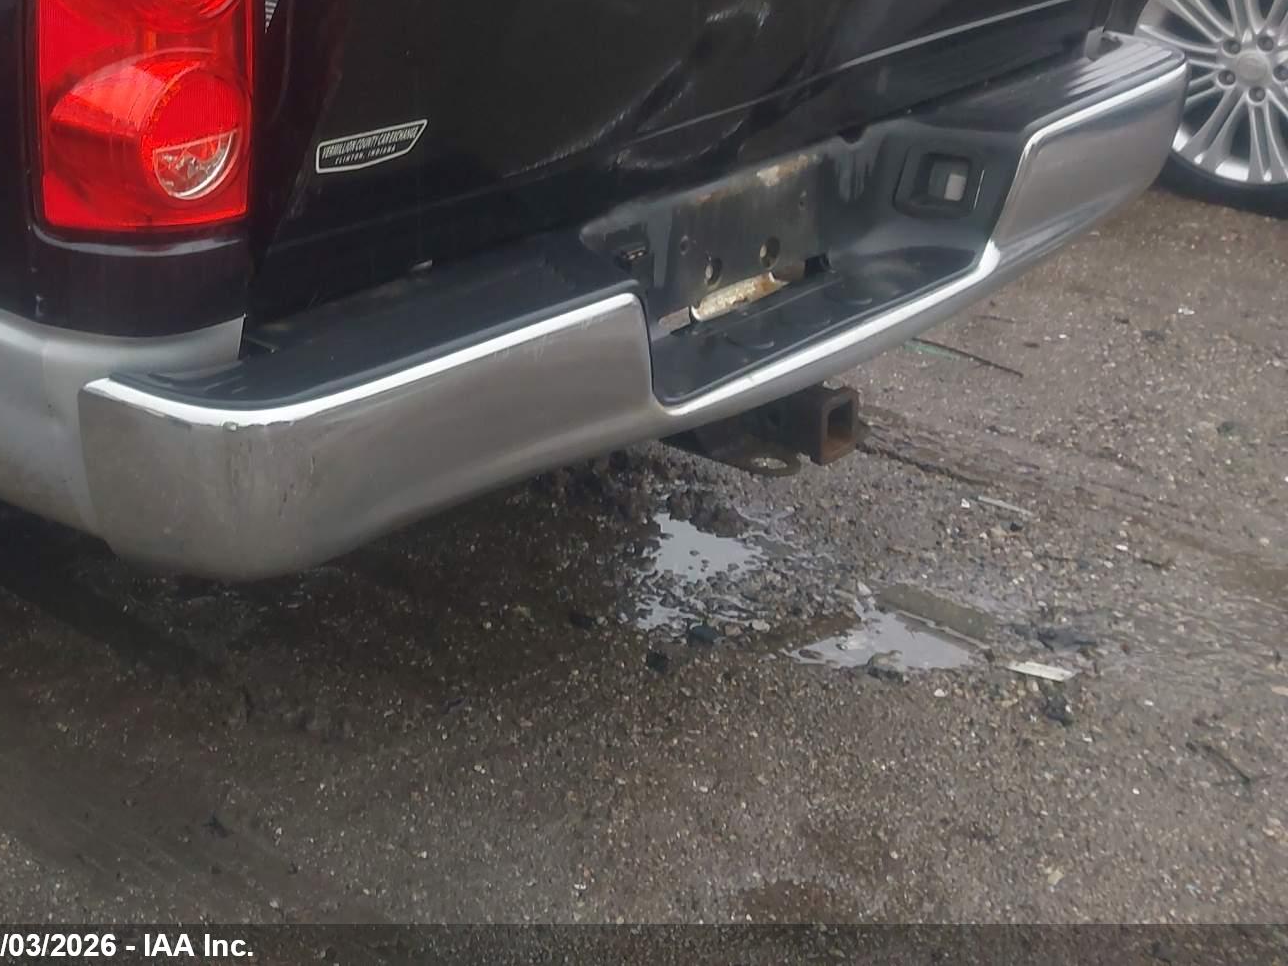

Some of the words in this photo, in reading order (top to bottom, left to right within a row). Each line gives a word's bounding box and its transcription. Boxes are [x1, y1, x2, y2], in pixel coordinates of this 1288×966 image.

[355, 135, 379, 151] COUNTY
[378, 132, 391, 146] CAR
[389, 126, 419, 143] EXCHANGE
[367, 145, 396, 157] INDIANA
